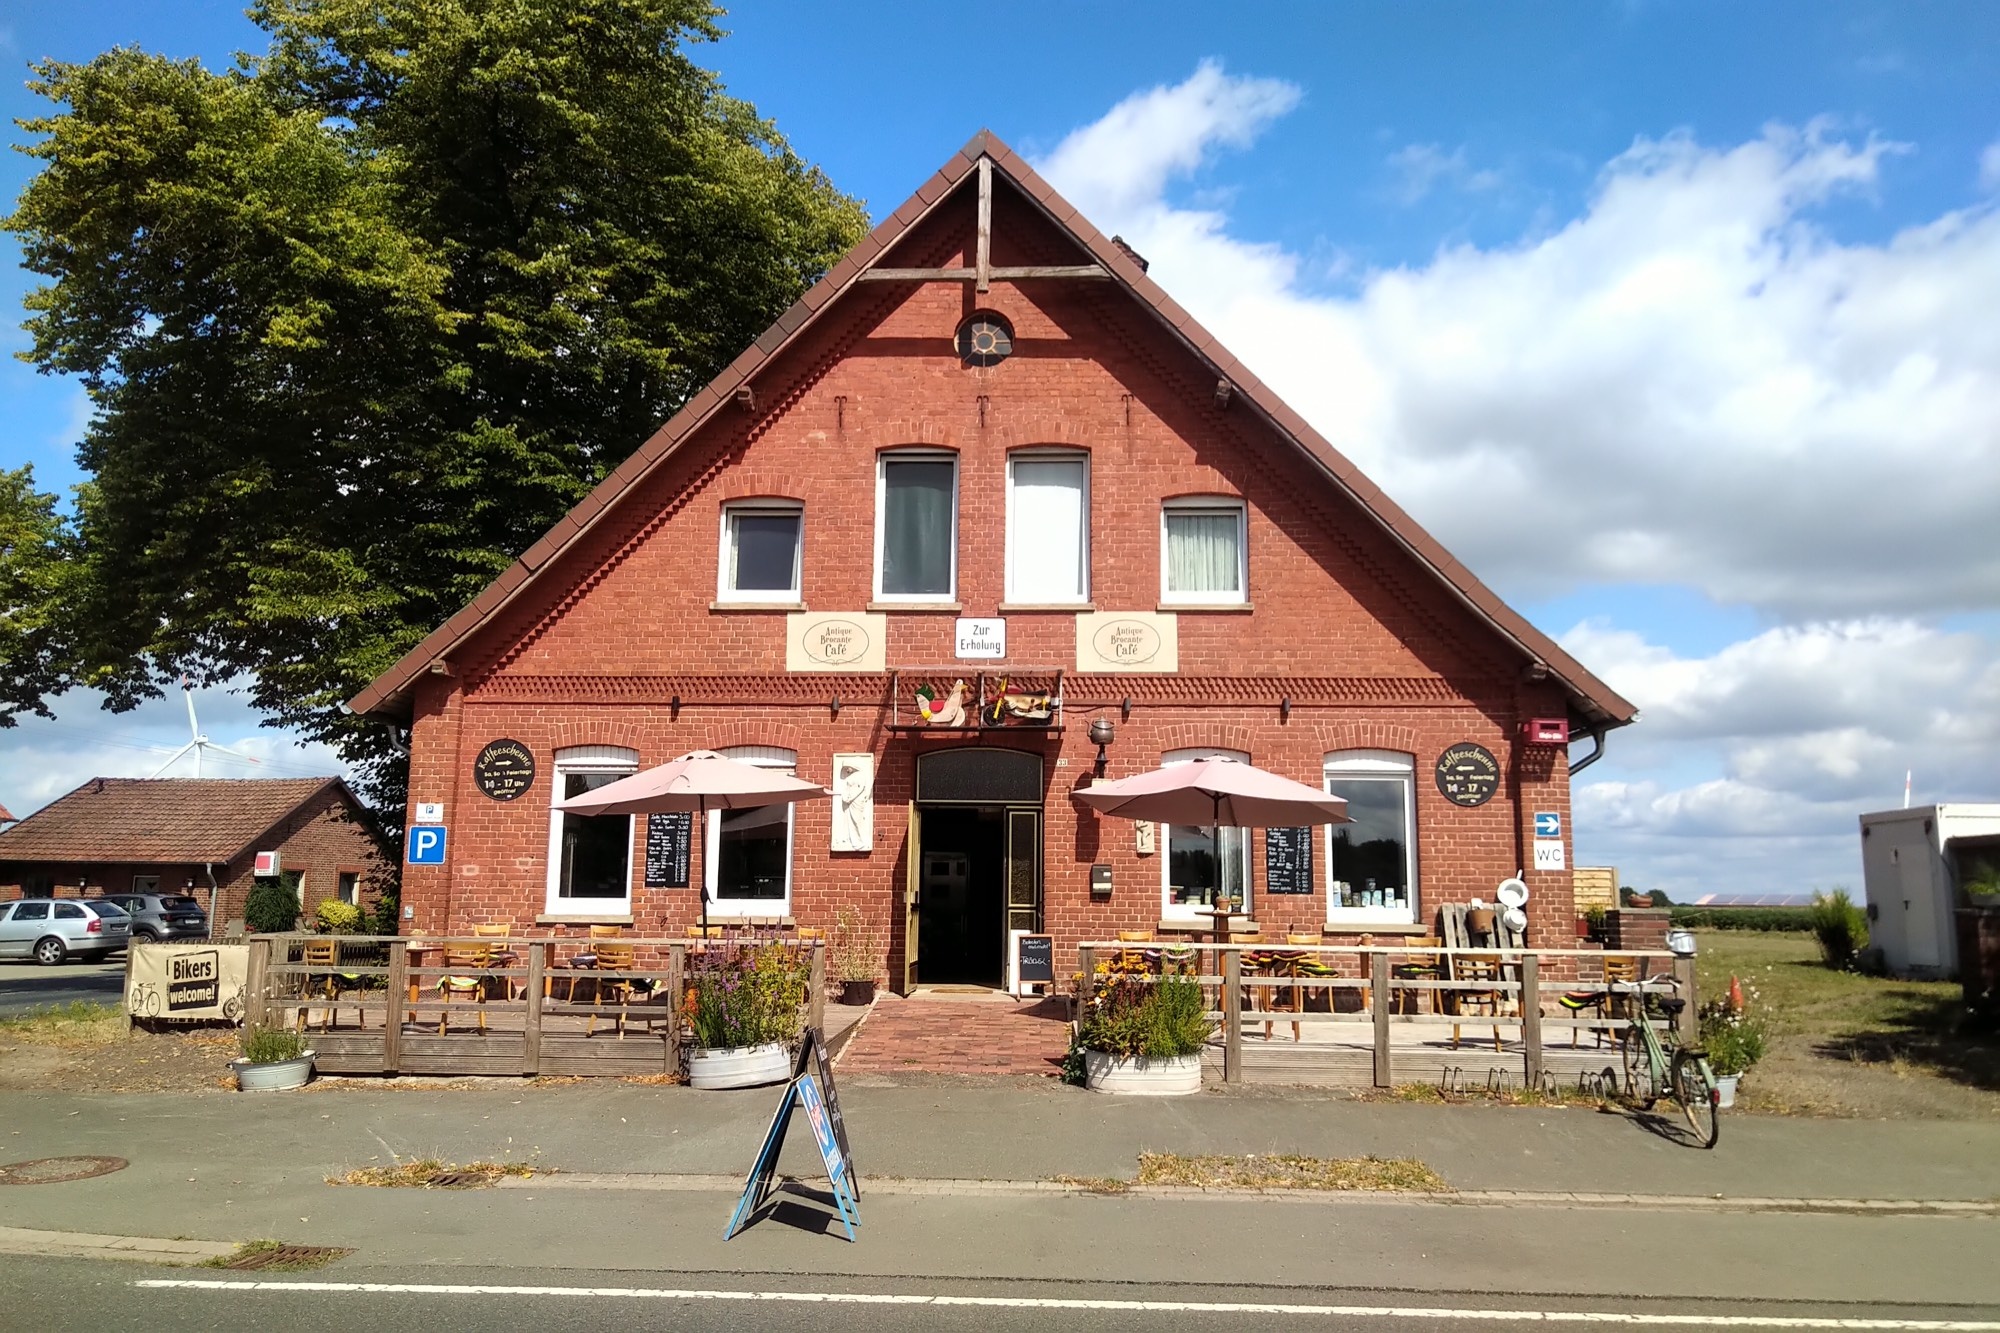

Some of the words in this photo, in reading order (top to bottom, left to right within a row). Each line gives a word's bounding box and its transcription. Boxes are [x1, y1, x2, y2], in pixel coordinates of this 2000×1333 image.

[825, 626, 852, 636] Antique
[973, 624, 990, 636] Zur
[1116, 626, 1143, 636] Antique
[820, 635, 852, 645] Brocante
[960, 638, 1001, 654] Erholung
[1110, 635, 1143, 645] Brocante
[825, 643, 847, 657] Café
[1116, 643, 1138, 657] Café
[477, 743, 532, 770] Kaffeescheune
[1438, 747, 1497, 773] Kaffeescheune
[503, 778, 514, 788] 17
[1467, 783, 1478, 792] 17
[493, 788, 517, 796] geöffnet
[416, 830, 438, 859] P
[1536, 848, 1561, 861] WC
[173, 958, 212, 980] Bikers
[169, 984, 216, 1004] welcome!
